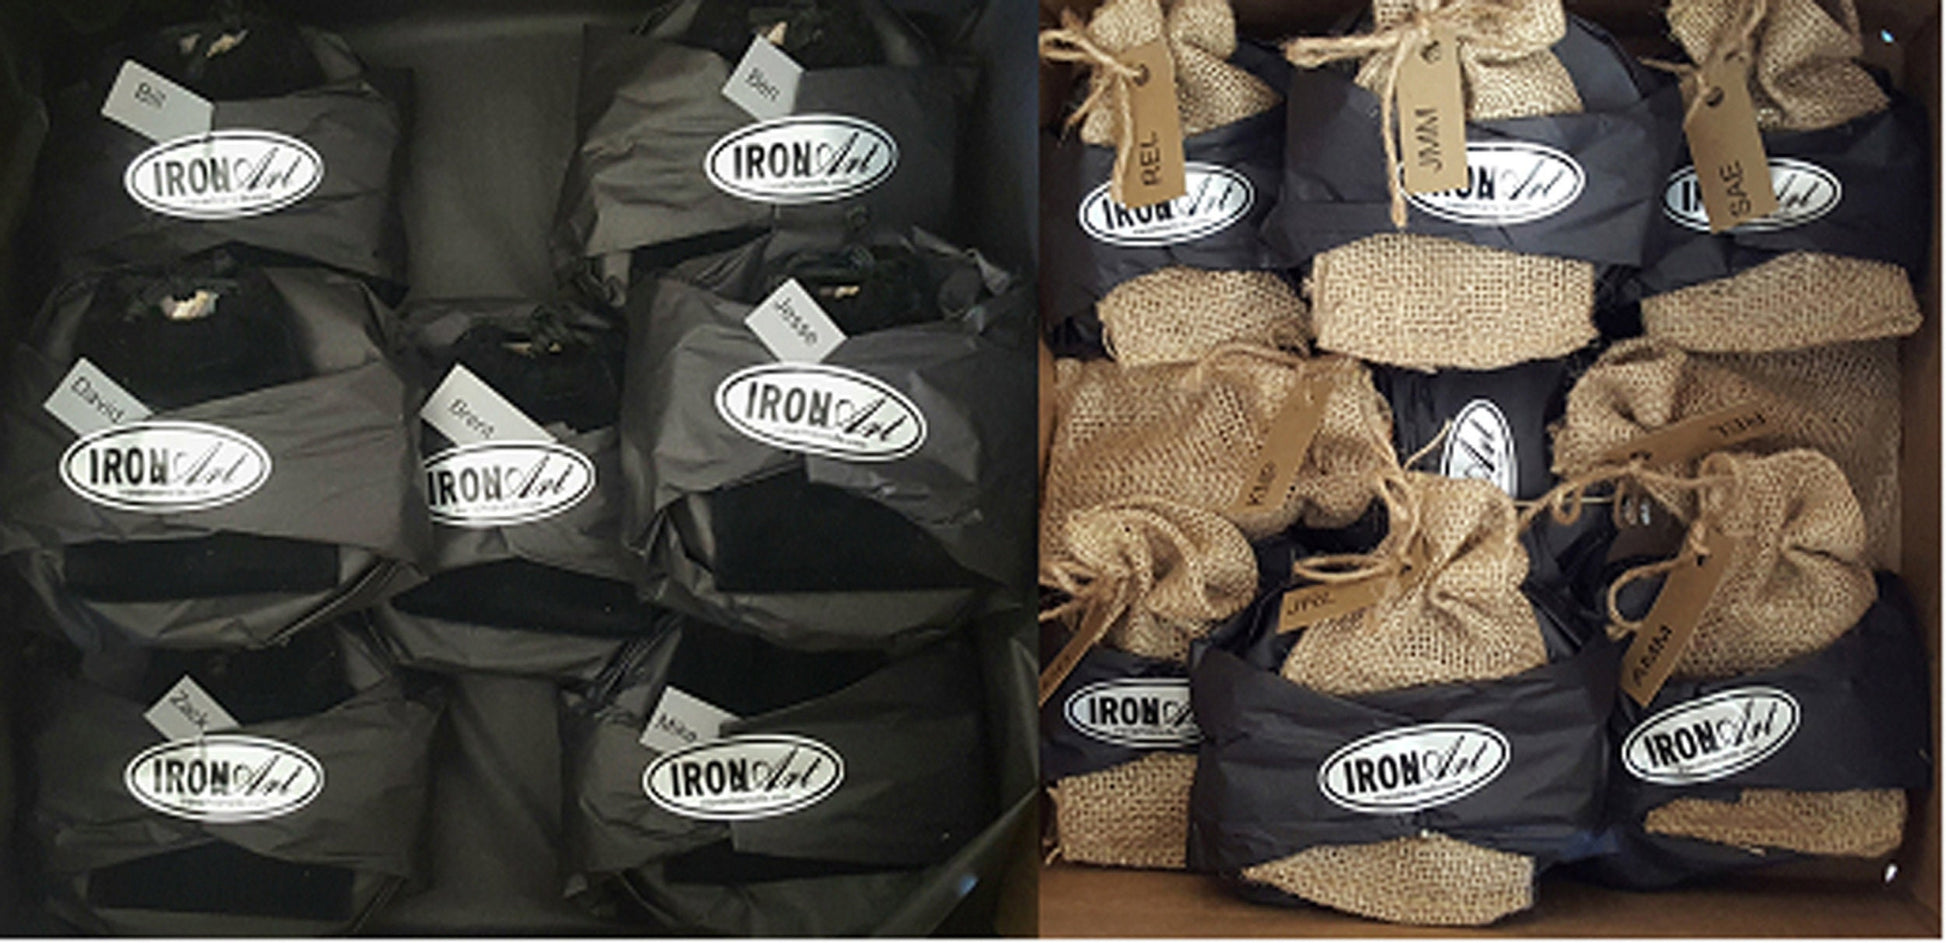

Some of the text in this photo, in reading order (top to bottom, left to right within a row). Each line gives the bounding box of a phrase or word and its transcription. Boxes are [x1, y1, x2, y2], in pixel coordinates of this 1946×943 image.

[135, 81, 167, 108] Bill
[746, 68, 780, 101] Ben
[733, 131, 880, 179] IRON Art
[1140, 131, 1160, 186] REL
[1414, 108, 1443, 173] JMM
[154, 146, 297, 197] IRON Art
[1501, 159, 1565, 201] Art
[1719, 160, 1751, 217] SAE
[773, 297, 819, 347] Jesse
[71, 377, 125, 424] David
[449, 398, 495, 440] Brent
[746, 381, 834, 428] IRON
[835, 398, 908, 442] Art
[88, 440, 253, 486] IRON Art
[427, 454, 574, 506] IRON Art
[169, 688, 210, 729] Zack
[654, 712, 698, 743] Mike
[1089, 696, 1160, 726] IRON
[1643, 719, 1720, 769] IRON
[1716, 700, 1778, 747] Art
[152, 753, 303, 797] IRON Art
[670, 744, 822, 798] IRON Art
[1343, 749, 1422, 795] IRON
[1422, 735, 1488, 781] Art
